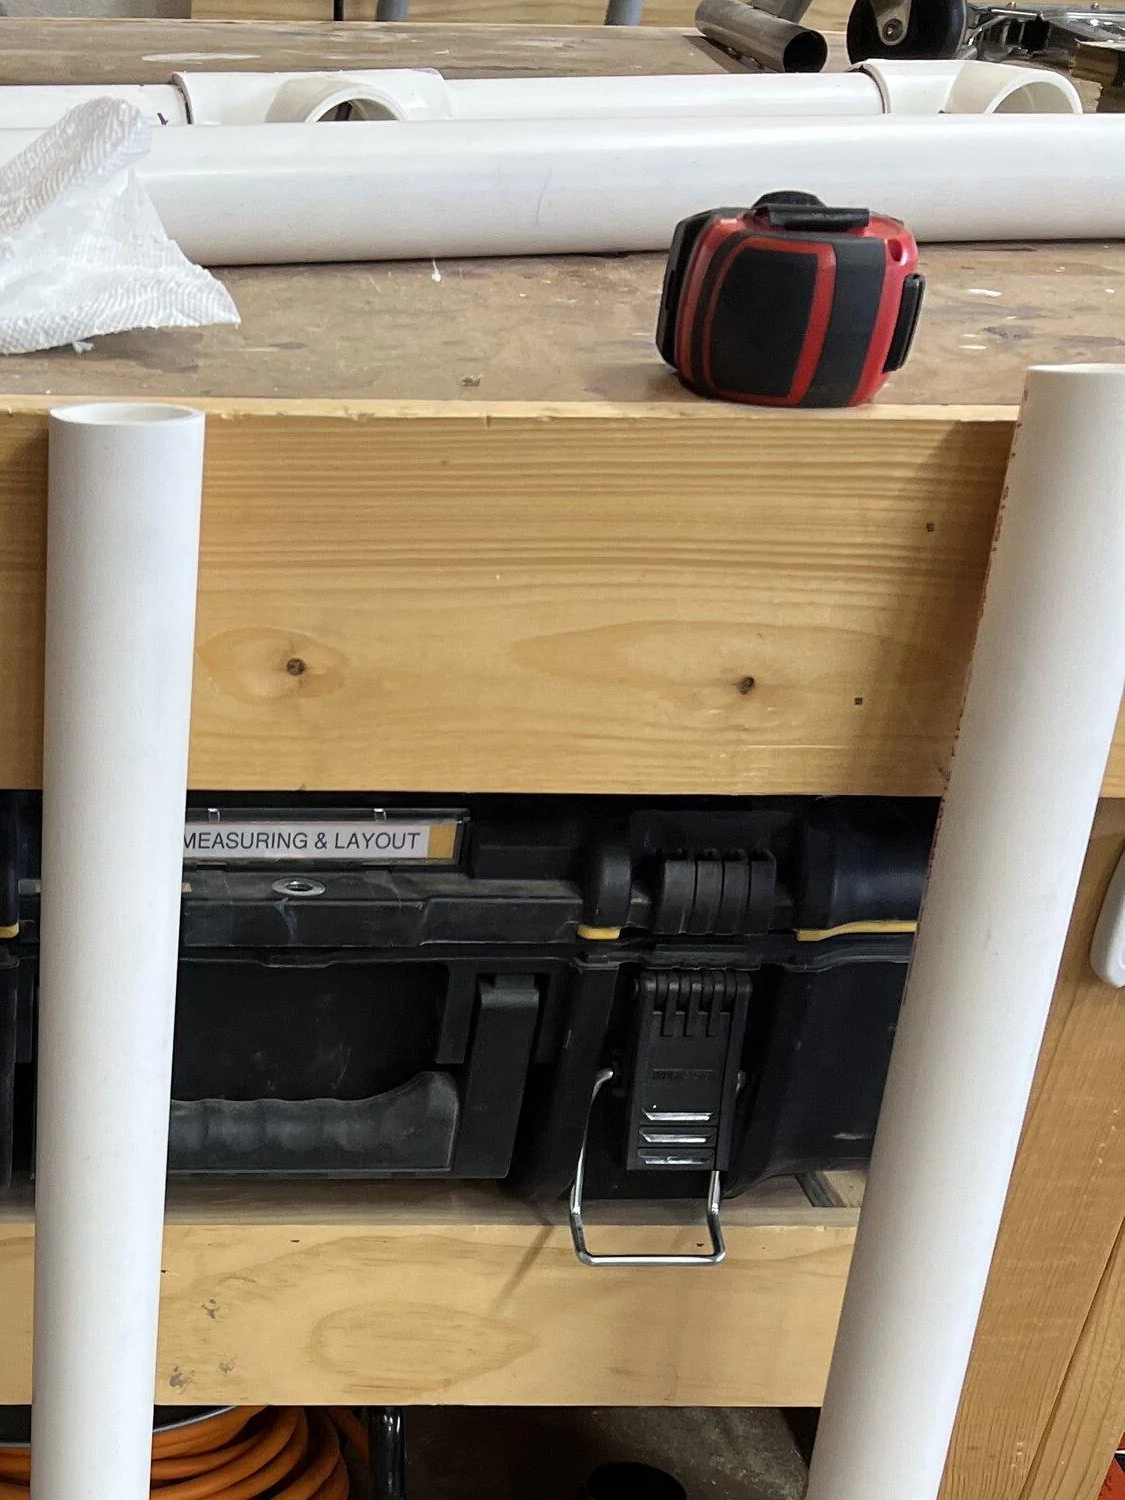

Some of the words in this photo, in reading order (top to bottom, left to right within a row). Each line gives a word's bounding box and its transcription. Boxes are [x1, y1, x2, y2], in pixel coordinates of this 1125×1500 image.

[183, 831, 308, 850] MEASURING
[313, 831, 328, 850] &
[333, 831, 421, 850] LAYOUT
